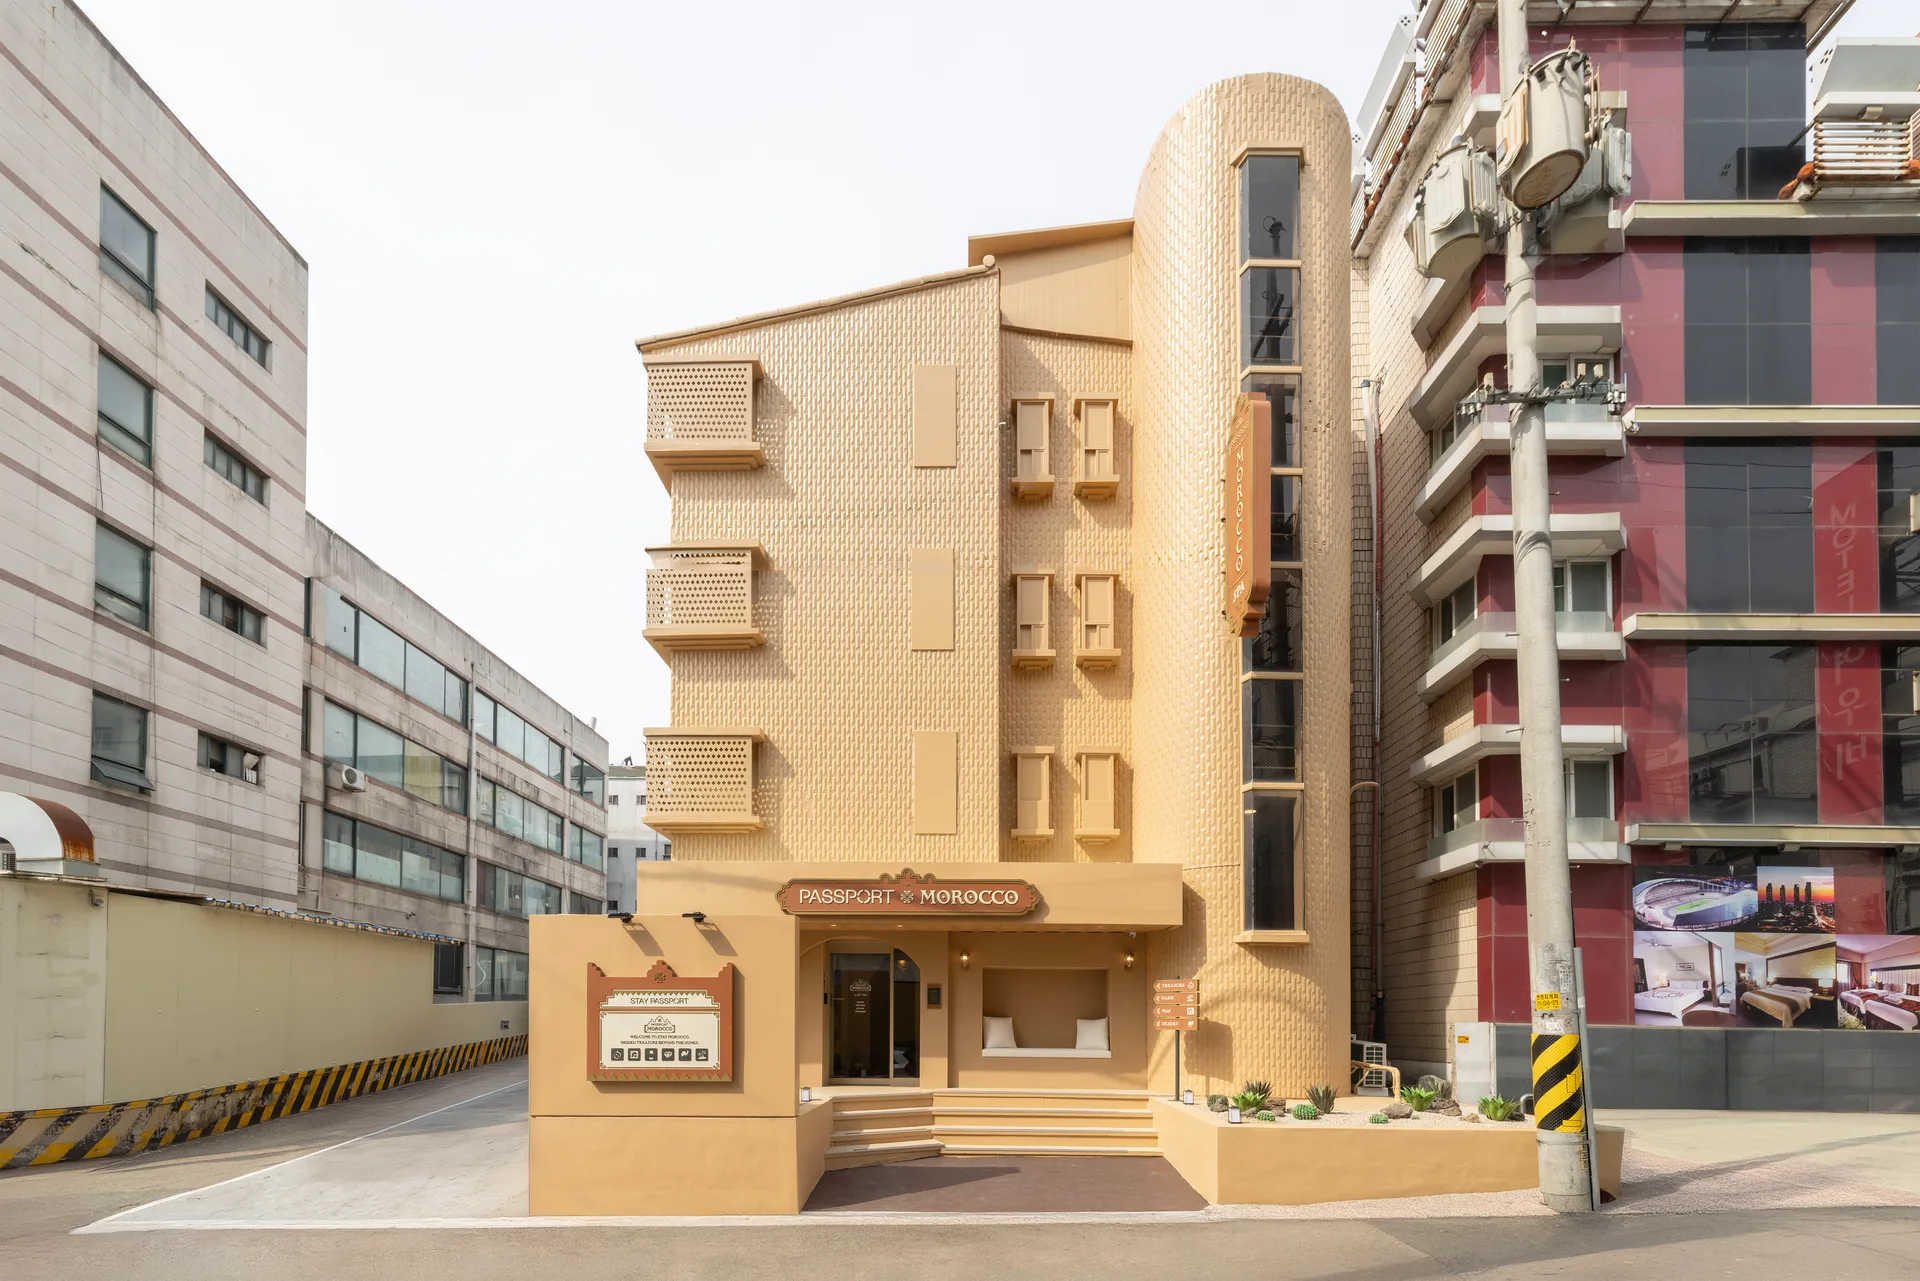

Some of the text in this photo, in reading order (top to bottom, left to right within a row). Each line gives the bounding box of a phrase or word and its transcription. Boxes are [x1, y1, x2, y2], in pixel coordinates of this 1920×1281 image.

[1234, 446, 1245, 573] MOROCCO
[1232, 586, 1246, 604] SPA
[799, 889, 1019, 905] PASSPORT MOROCCO
[630, 997, 689, 1005] STAY PASSPORT
